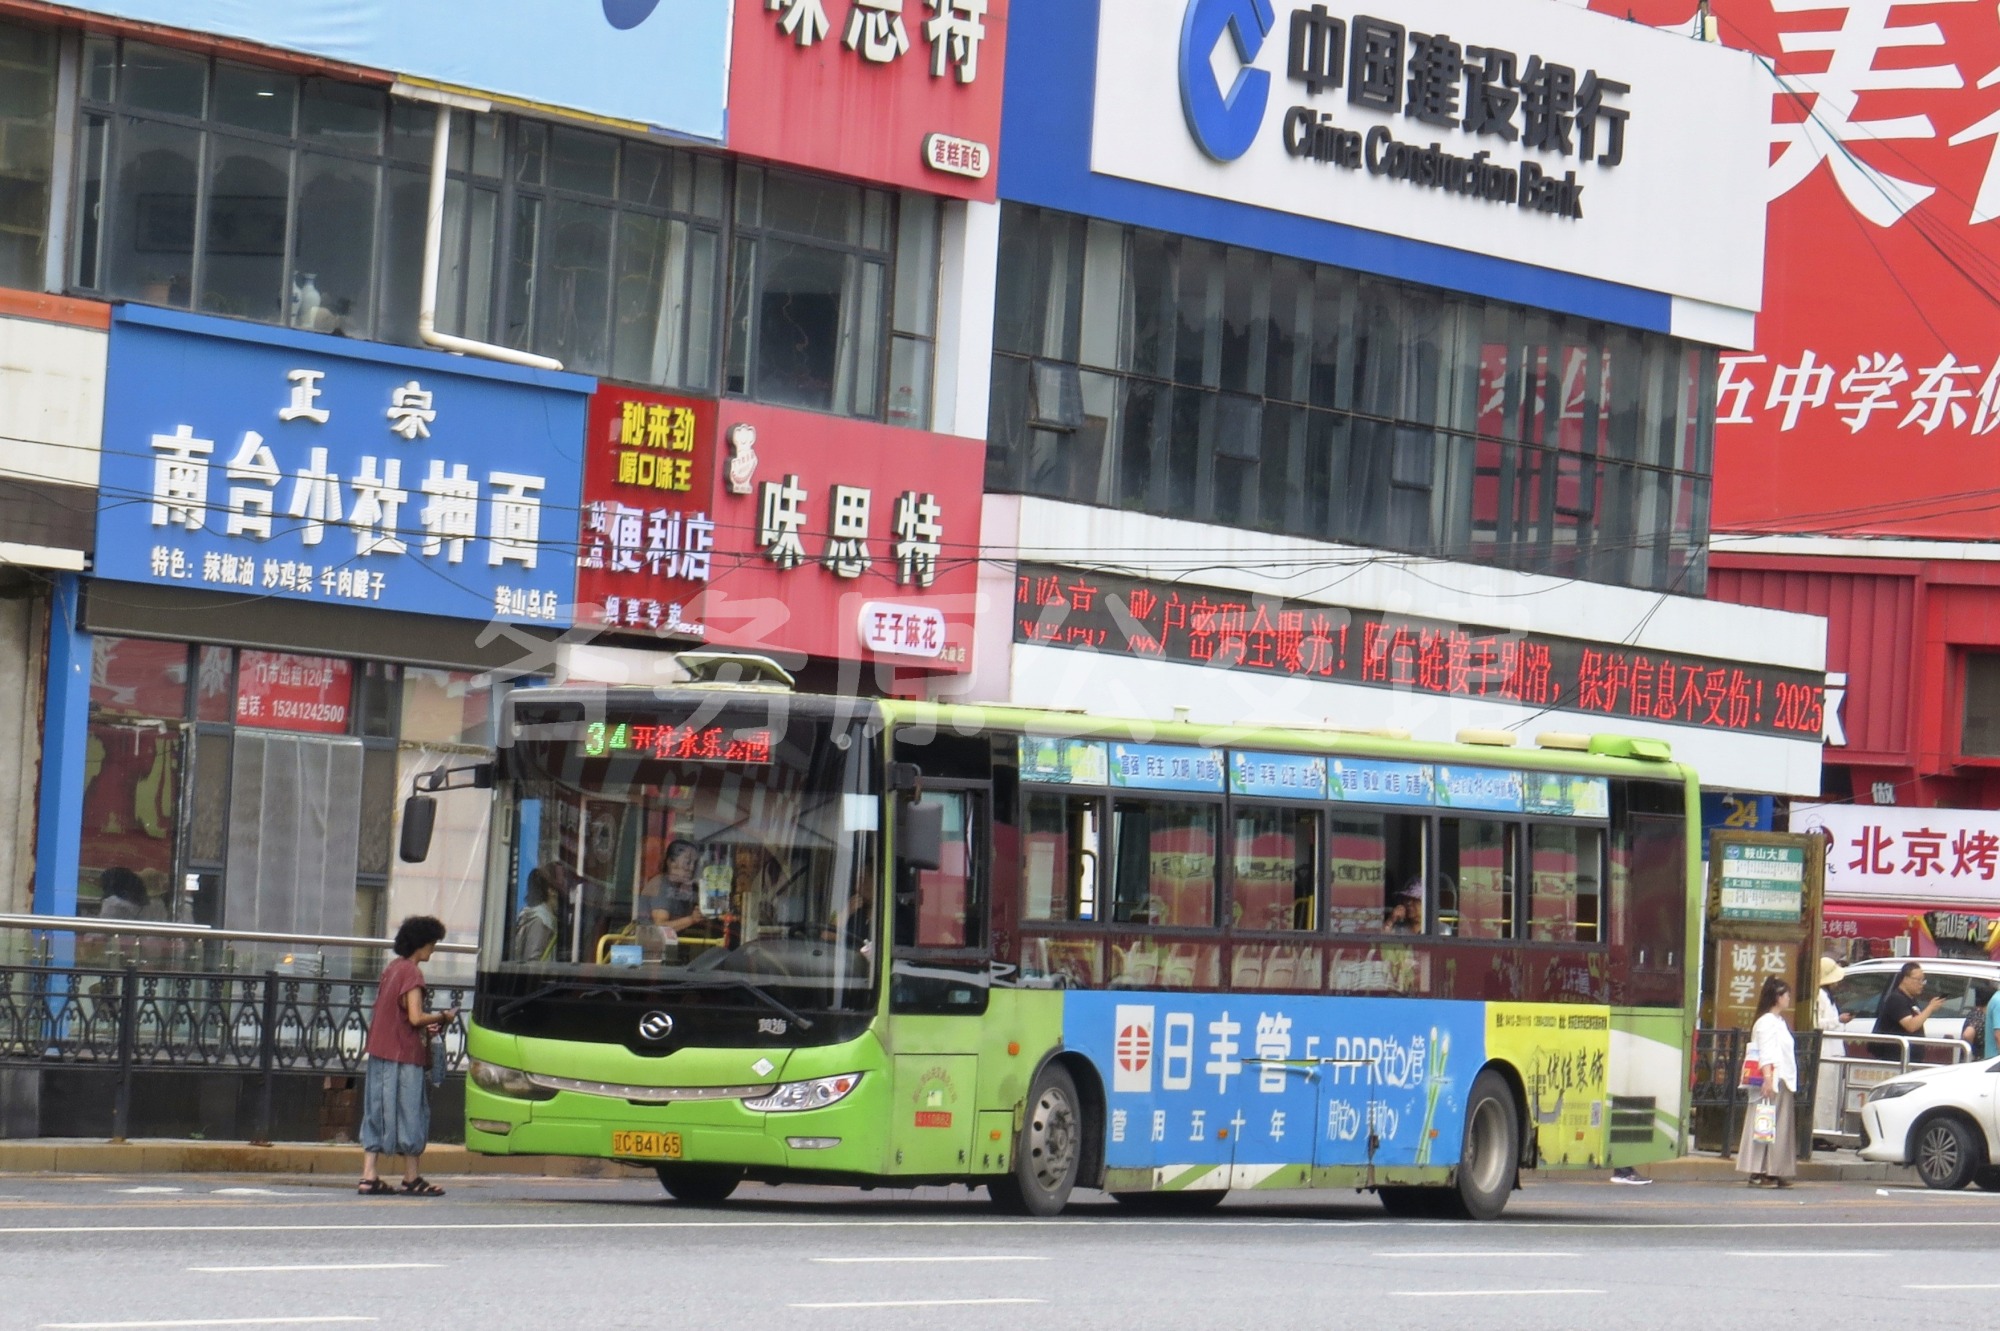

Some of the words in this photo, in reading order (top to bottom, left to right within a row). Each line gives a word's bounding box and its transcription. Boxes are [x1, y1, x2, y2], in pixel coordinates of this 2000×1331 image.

[1287, 4, 1631, 166] 中国建设银行
[1767, 0, 2000, 227] 美
[935, 138, 981, 172] 蛋糕面包
[1284, 105, 1362, 170] China
[1366, 124, 1517, 204] Construction
[1519, 160, 1583, 219] Bank
[279, 369, 436, 440] 正宗
[621, 402, 695, 452] 秒来劲
[618, 451, 692, 491] 嚼口味王
[151, 425, 546, 568] 南台小杜抻面
[590, 501, 607, 568] 站点
[609, 502, 714, 581] 便利店
[756, 474, 943, 588] 味思特
[151, 545, 193, 579] 特色：
[203, 551, 255, 586] 辣椒油
[262, 558, 313, 593] 炒鸡架
[320, 565, 386, 600] 牛肉腱子
[495, 585, 557, 620] 鞍山总店
[605, 595, 682, 628] 烟草专卖
[871, 611, 937, 649] 王子麻花
[256, 662, 333, 688] 门市出租120平
[237, 695, 266, 718] 电话：
[272, 700, 345, 723] 15241242500
[584, 722, 627, 756] 34
[1121, 755, 1139, 776] 富强
[1146, 757, 1166, 778] 民主
[1171, 758, 1190, 780] 文明
[1260, 764, 1276, 786] 平等
[1281, 765, 1297, 788] 公正
[1385, 770, 1400, 793] 诚信
[1406, 772, 1421, 795] 友善
[1848, 824, 2000, 881] 北京烤
[1730, 945, 1787, 974] 诚达
[1162, 1011, 1292, 1094] 日丰管
[1111, 1108, 1287, 1143] 管用五十年
